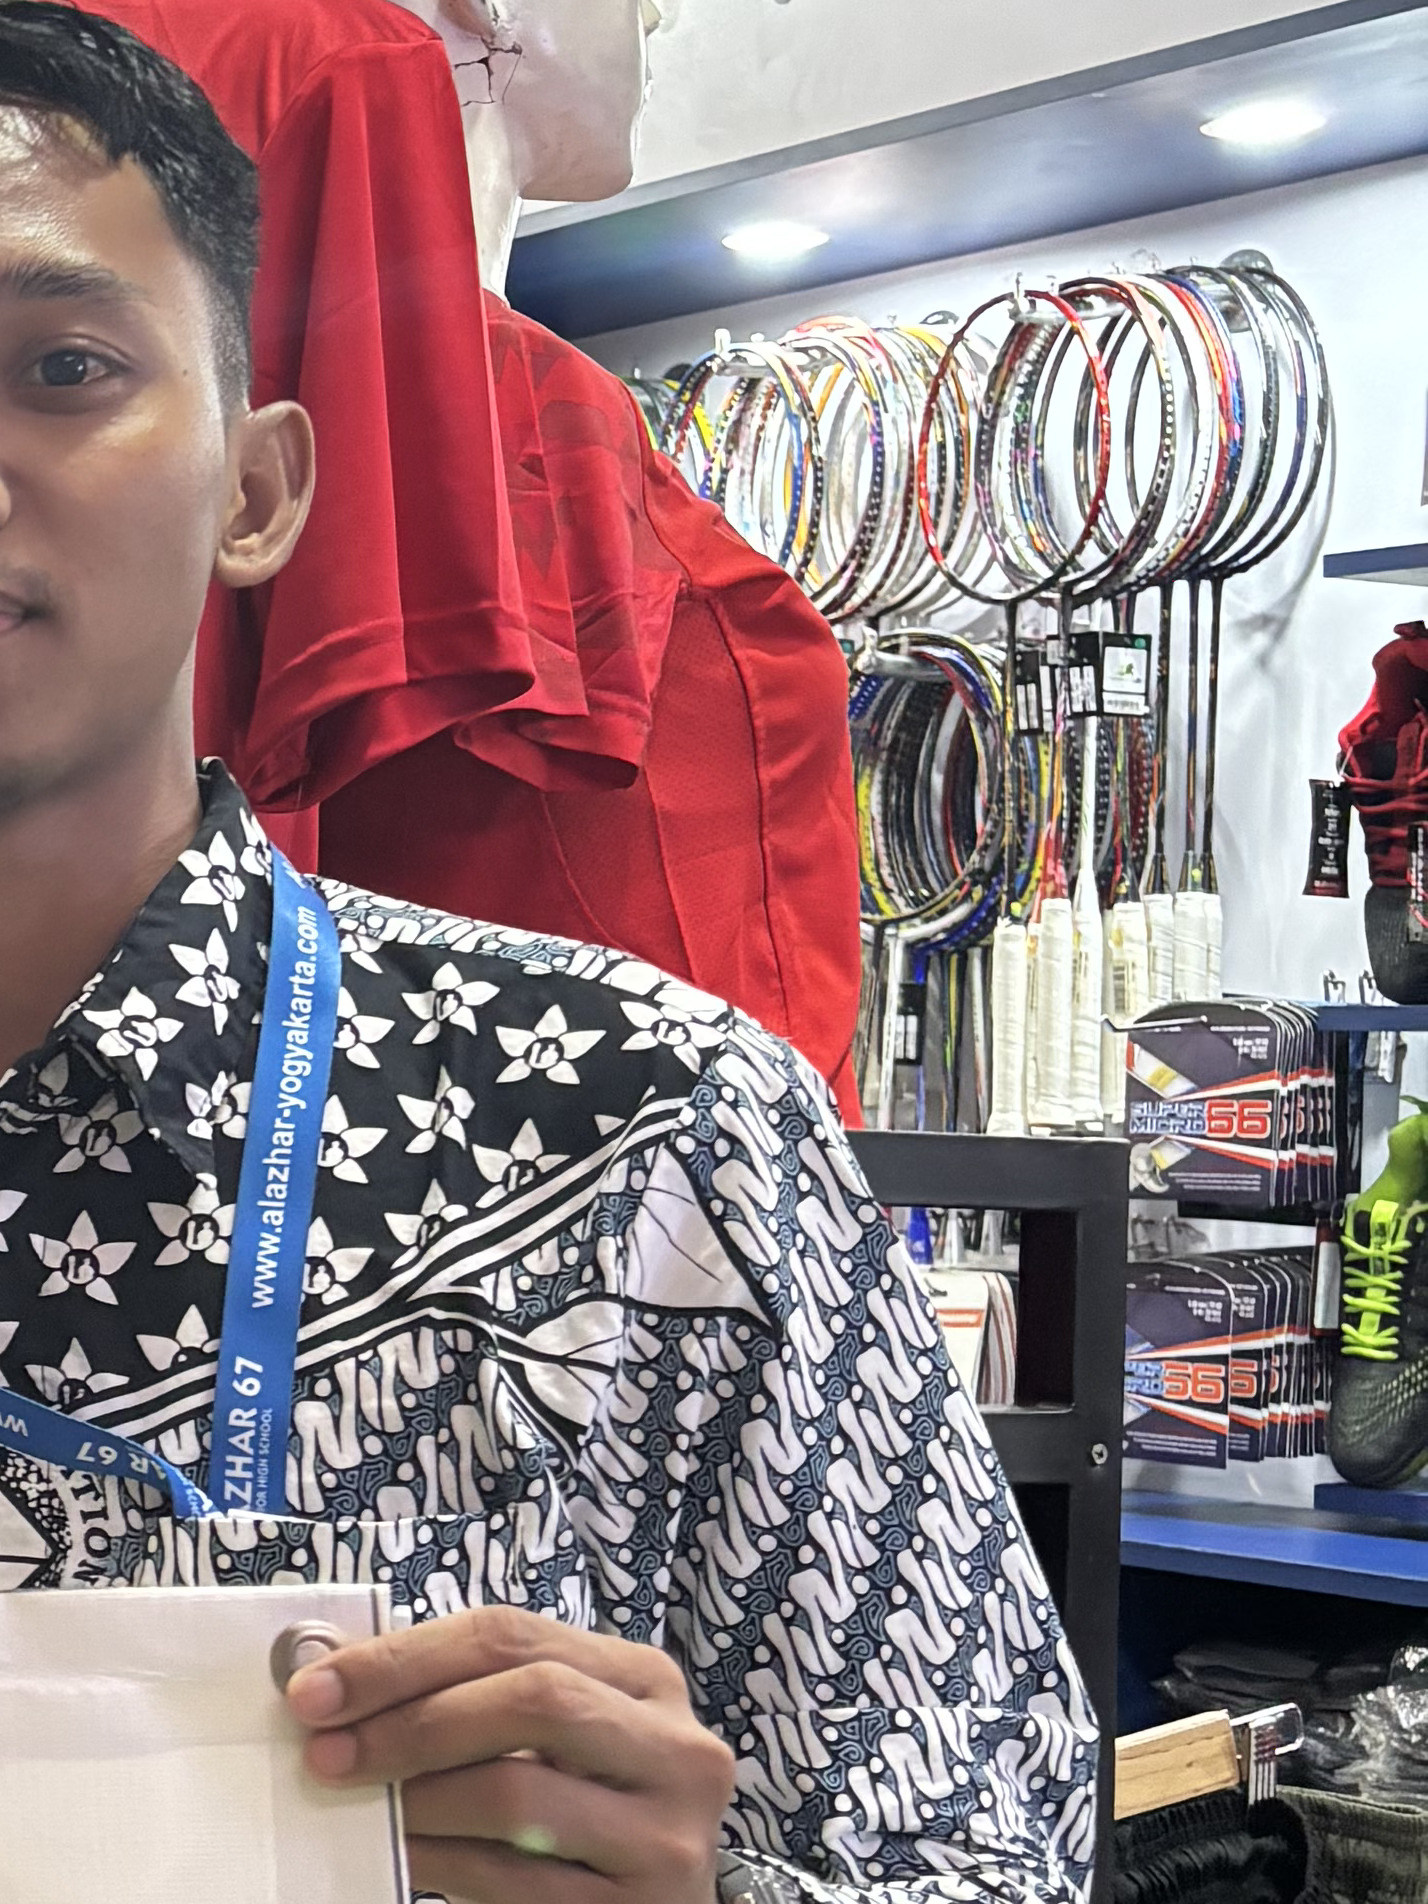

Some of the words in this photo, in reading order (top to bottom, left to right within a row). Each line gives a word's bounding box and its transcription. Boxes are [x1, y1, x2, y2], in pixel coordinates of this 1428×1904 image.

[250, 904, 319, 1311] www.alazhar-yogyakarta.com
[1205, 1099, 1272, 1139] 66
[232, 1355, 264, 1397] 67
[1162, 1359, 1226, 1405] 66
[258, 1406, 274, 1456] SCHOOL
[256, 1458, 269, 1490] HIGH
